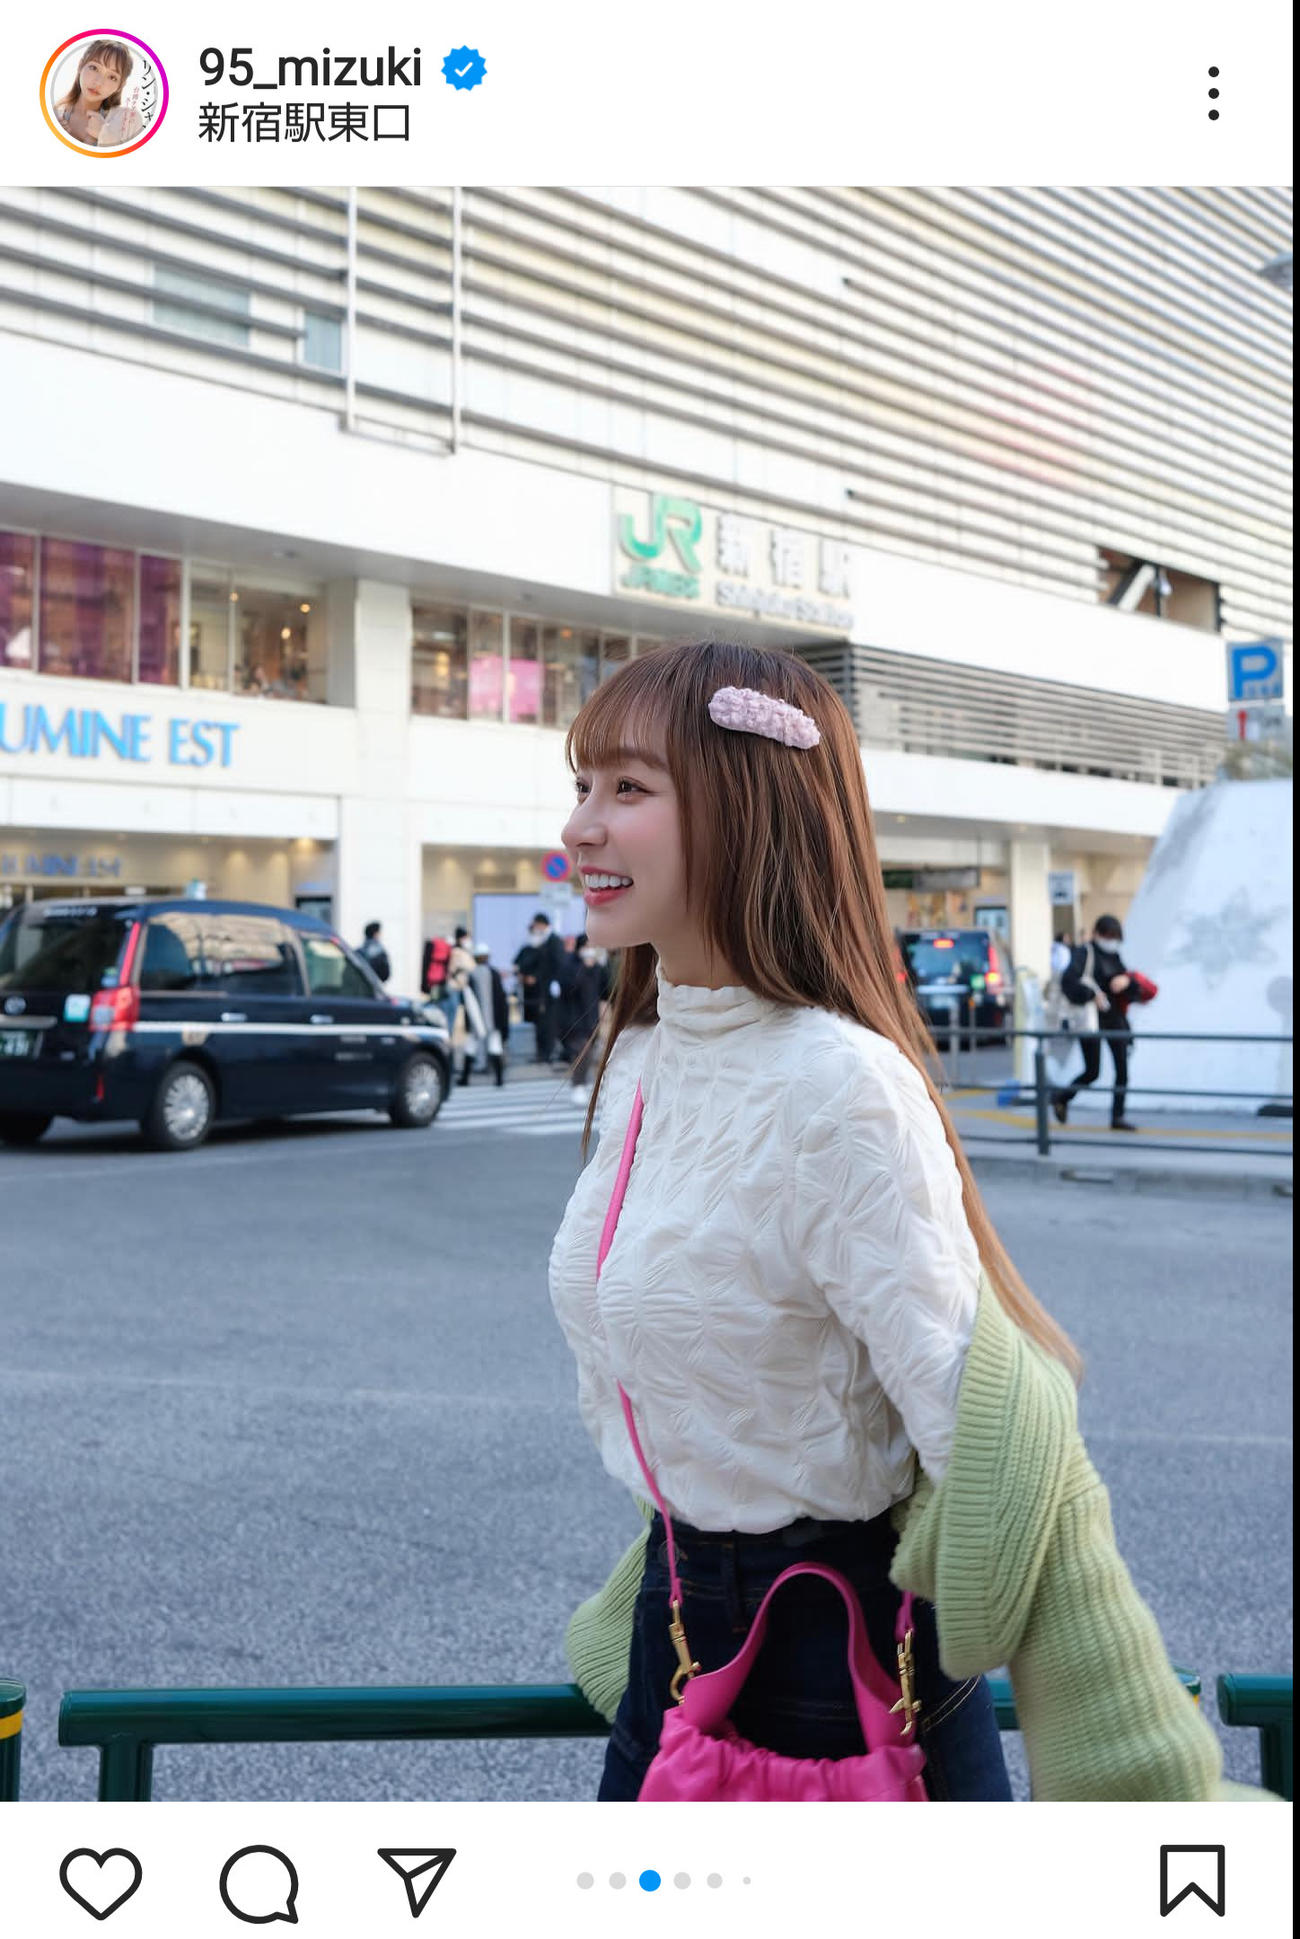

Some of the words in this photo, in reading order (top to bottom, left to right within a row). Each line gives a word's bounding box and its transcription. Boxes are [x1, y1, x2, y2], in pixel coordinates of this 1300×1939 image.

[617, 492, 702, 574] JR
[1231, 646, 1277, 698] P
[169, 718, 239, 767] EST
